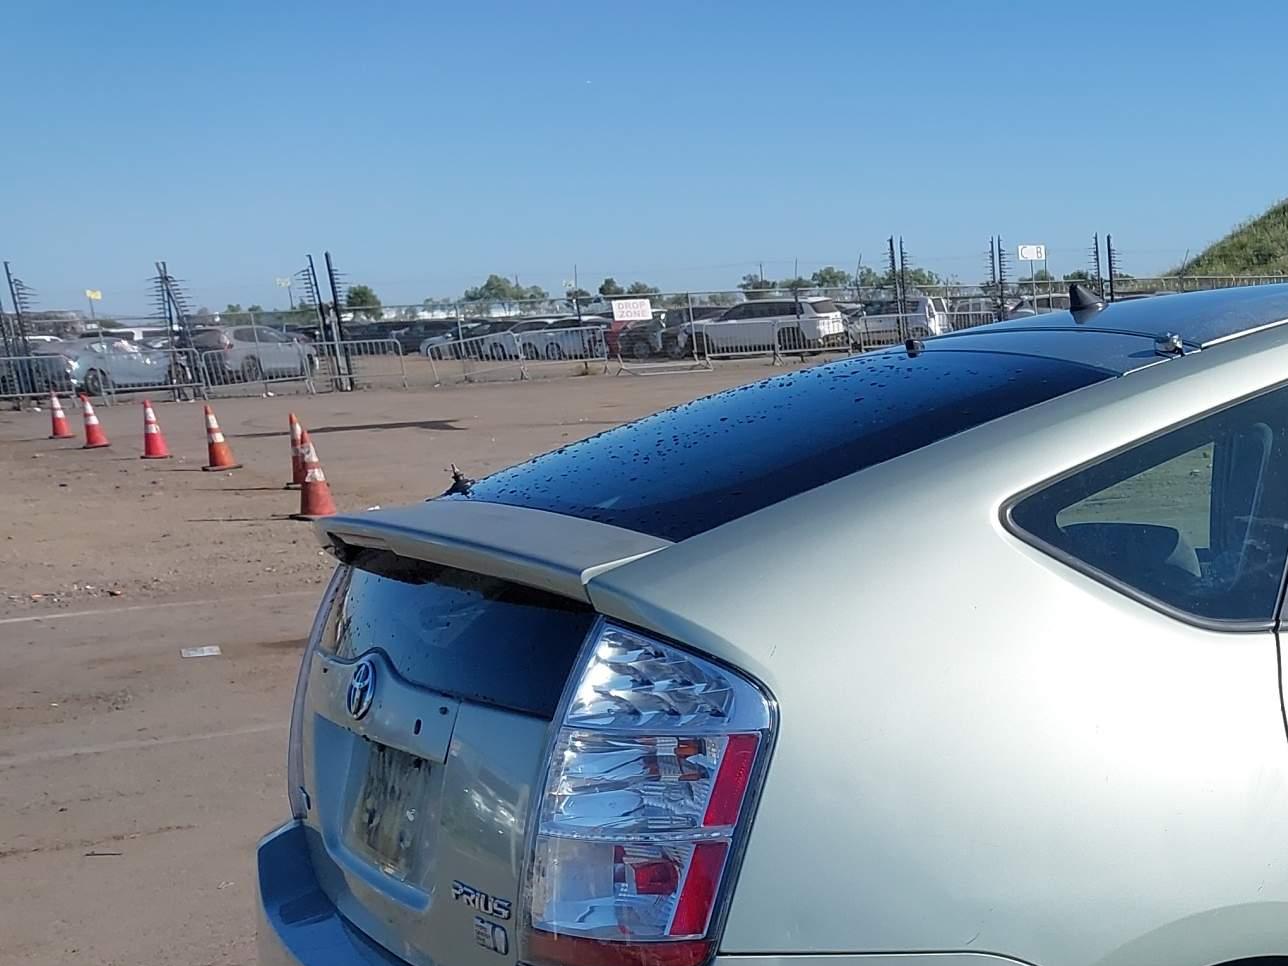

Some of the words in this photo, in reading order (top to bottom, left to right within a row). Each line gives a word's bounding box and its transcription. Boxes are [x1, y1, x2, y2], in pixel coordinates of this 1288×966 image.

[617, 301, 646, 310] DROP
[618, 310, 648, 319] ZONE
[451, 879, 512, 920] PRIUS
